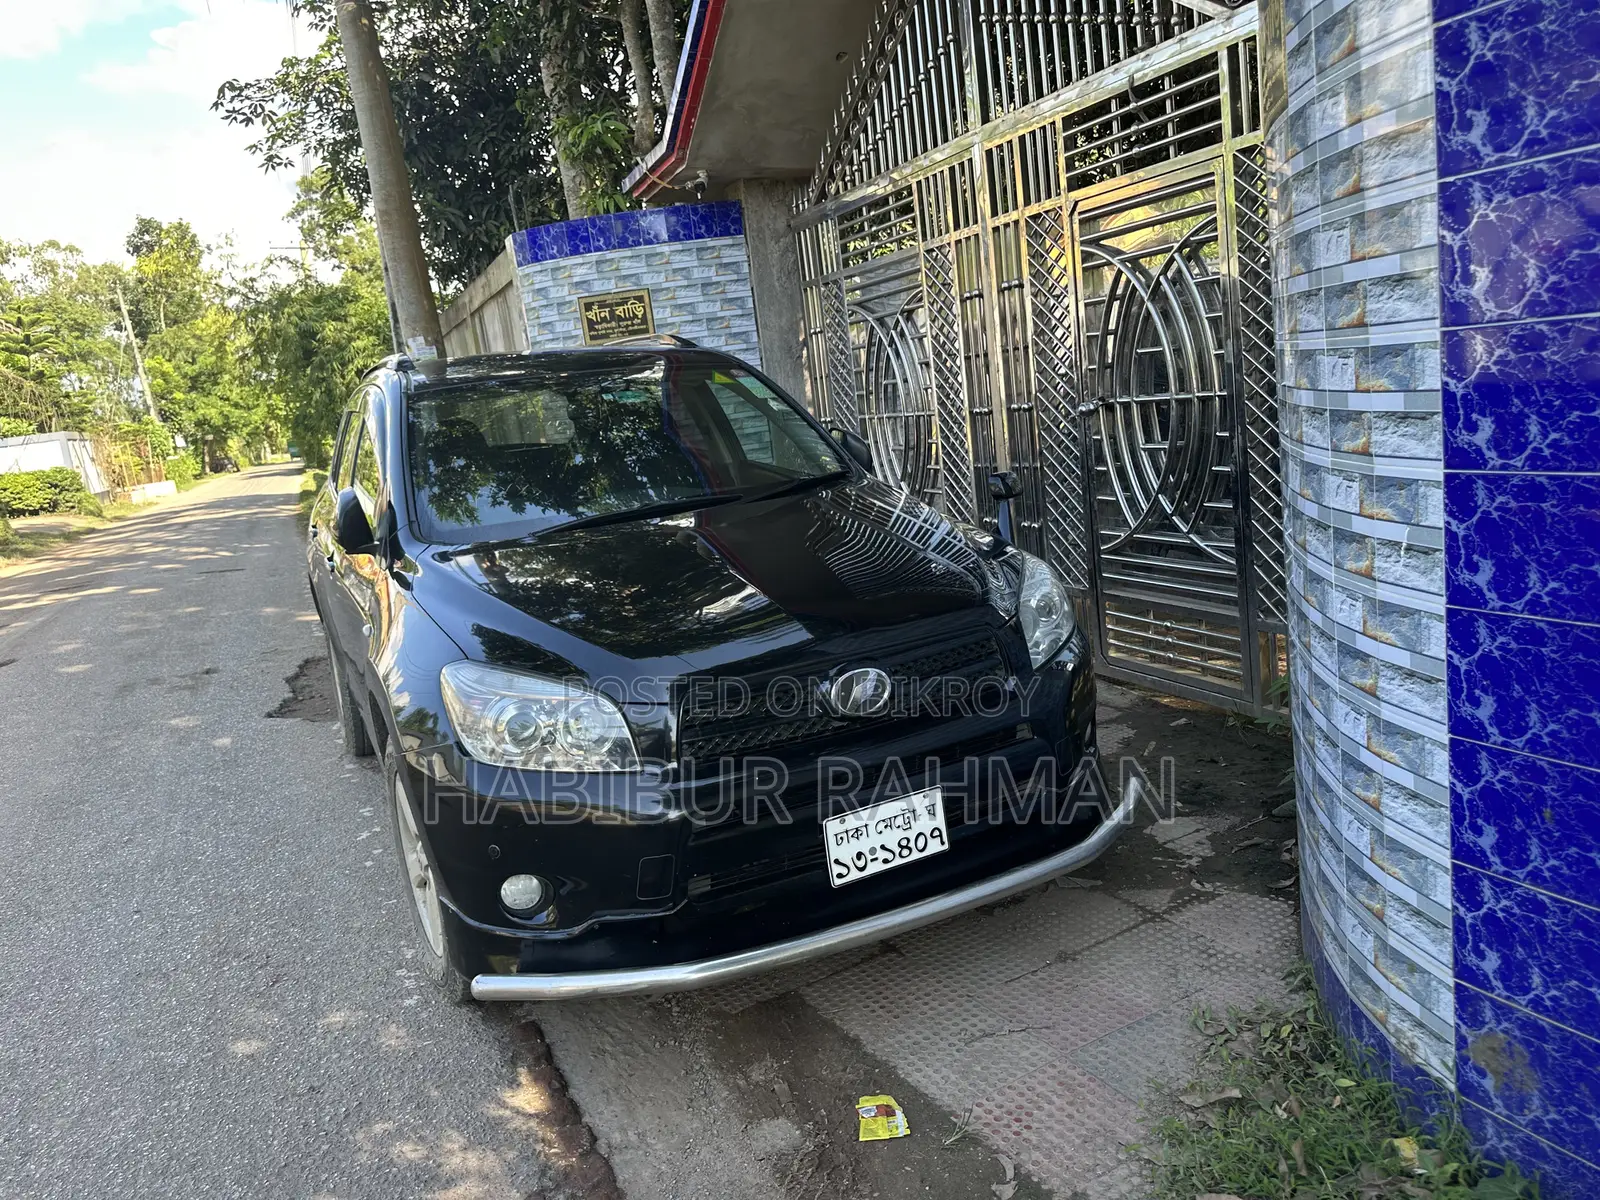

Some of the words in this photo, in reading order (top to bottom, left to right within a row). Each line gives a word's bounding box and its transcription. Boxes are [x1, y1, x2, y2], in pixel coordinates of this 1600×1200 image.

[612, 300, 645, 318] বাড়ি
[833, 822, 870, 847] ঢাকা
[833, 827, 946, 879] ১৩-১৪০৭
